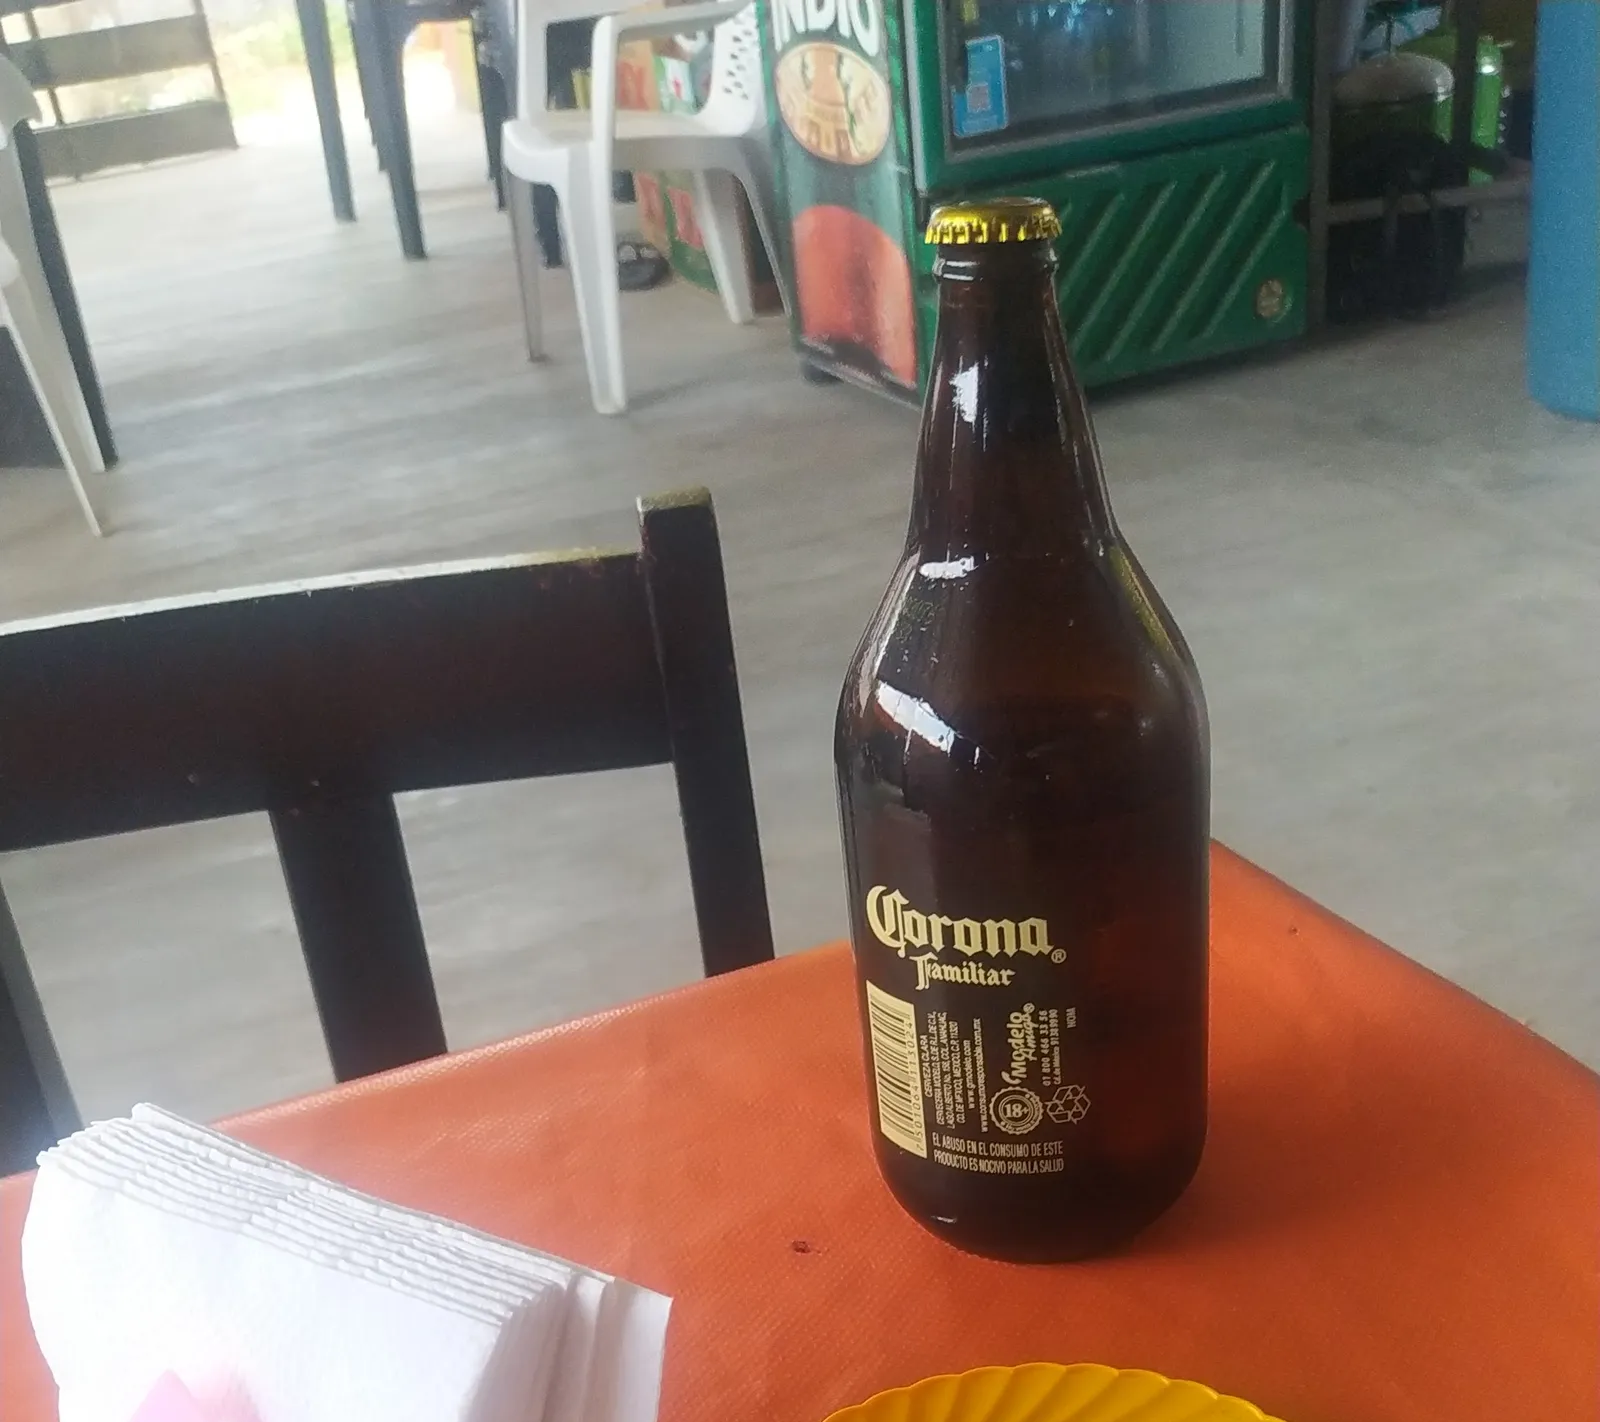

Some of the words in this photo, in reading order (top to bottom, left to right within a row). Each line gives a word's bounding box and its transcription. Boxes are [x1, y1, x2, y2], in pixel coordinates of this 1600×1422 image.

[866, 885, 1054, 958] Corona
[909, 952, 1016, 990] Familiar
[1065, 1007, 1077, 1029] NOM
[919, 1034, 930, 1062] CLARA
[1006, 1011, 1027, 1079] Modelo
[1020, 1012, 1039, 1061] Amigo
[1041, 1057, 1051, 1073] 800
[922, 1062, 933, 1098] CERVEZA
[1004, 1103, 1029, 1118] 18+
[932, 1132, 941, 1147] EL
[942, 1135, 966, 1153] ABUSO
[967, 1140, 977, 1155] EN
[979, 1141, 988, 1156] EL
[990, 1143, 1029, 1158] CONSUMO
[1031, 1143, 1042, 1157] DE
[1044, 1140, 1063, 1155] ESTE
[933, 1149, 968, 1170] PRODUCTO
[969, 1157, 978, 1172] ES
[979, 1158, 1006, 1174] NOCIVO
[1007, 1160, 1027, 1174] PARA
[1028, 1160, 1039, 1174] LA
[1040, 1158, 1064, 1173] SALUD
